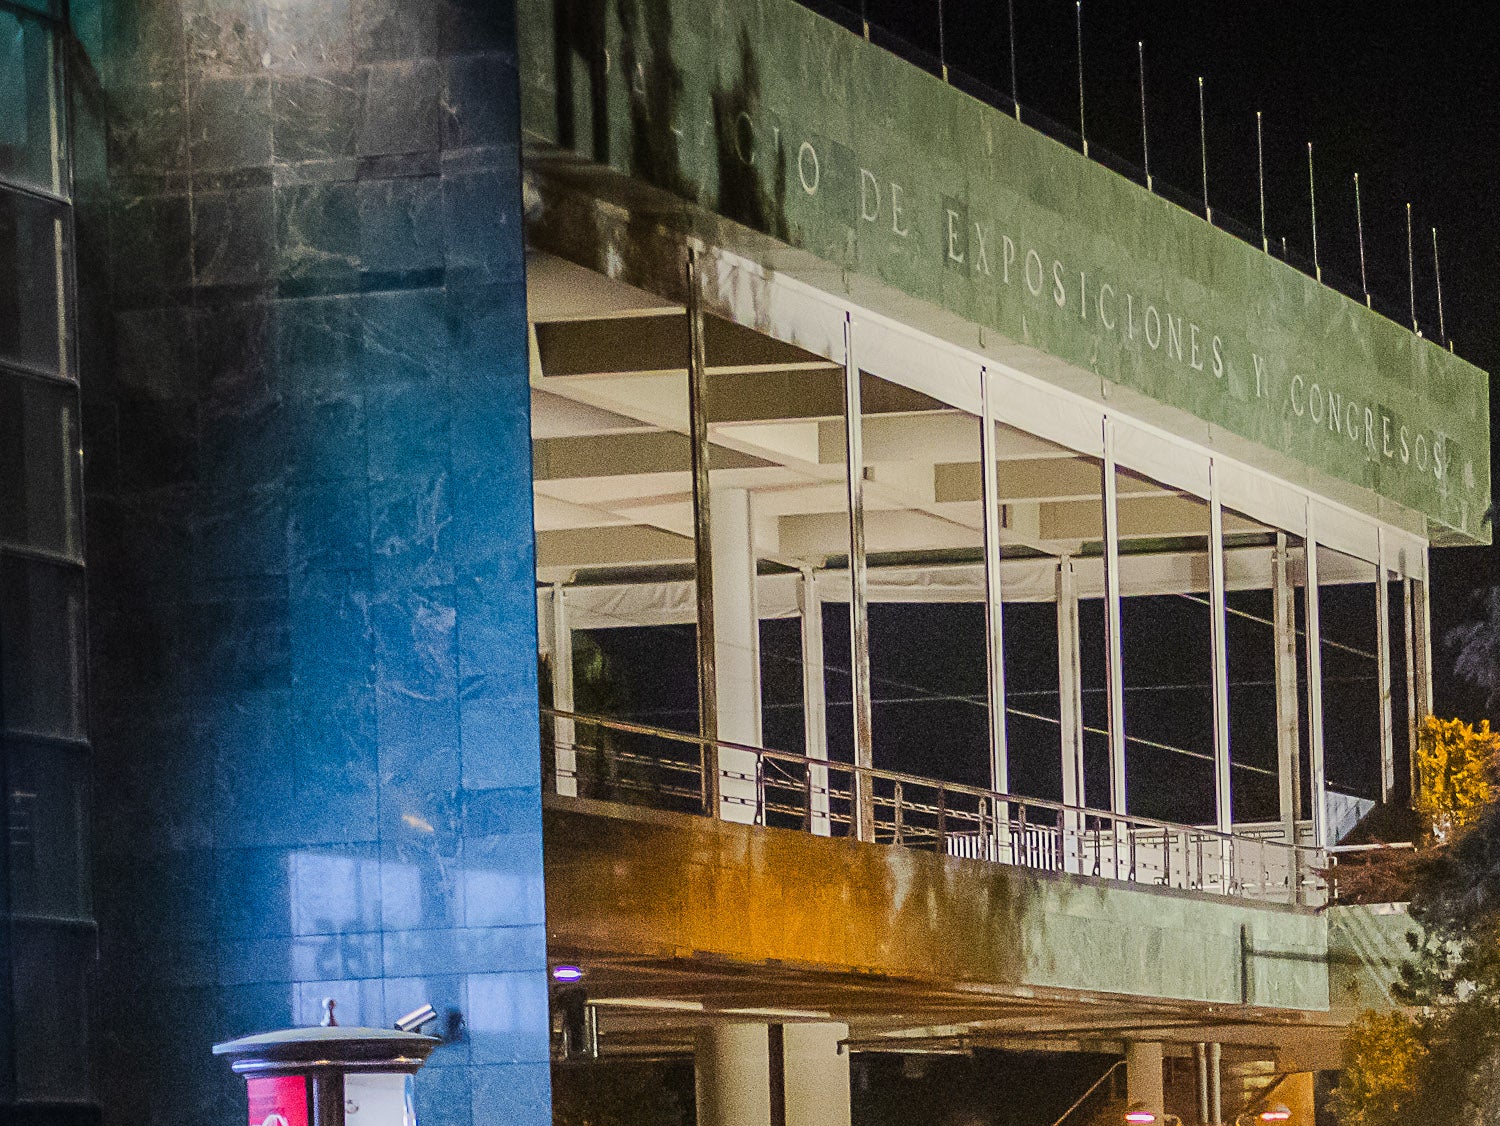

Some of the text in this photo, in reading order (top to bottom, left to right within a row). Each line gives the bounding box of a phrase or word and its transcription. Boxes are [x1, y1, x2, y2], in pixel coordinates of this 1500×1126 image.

[860, 168, 907, 237] DE
[946, 208, 1223, 379] EXPOSICIONES
[1252, 353, 1265, 398] Y
[1290, 374, 1443, 480] CONGRESOS
